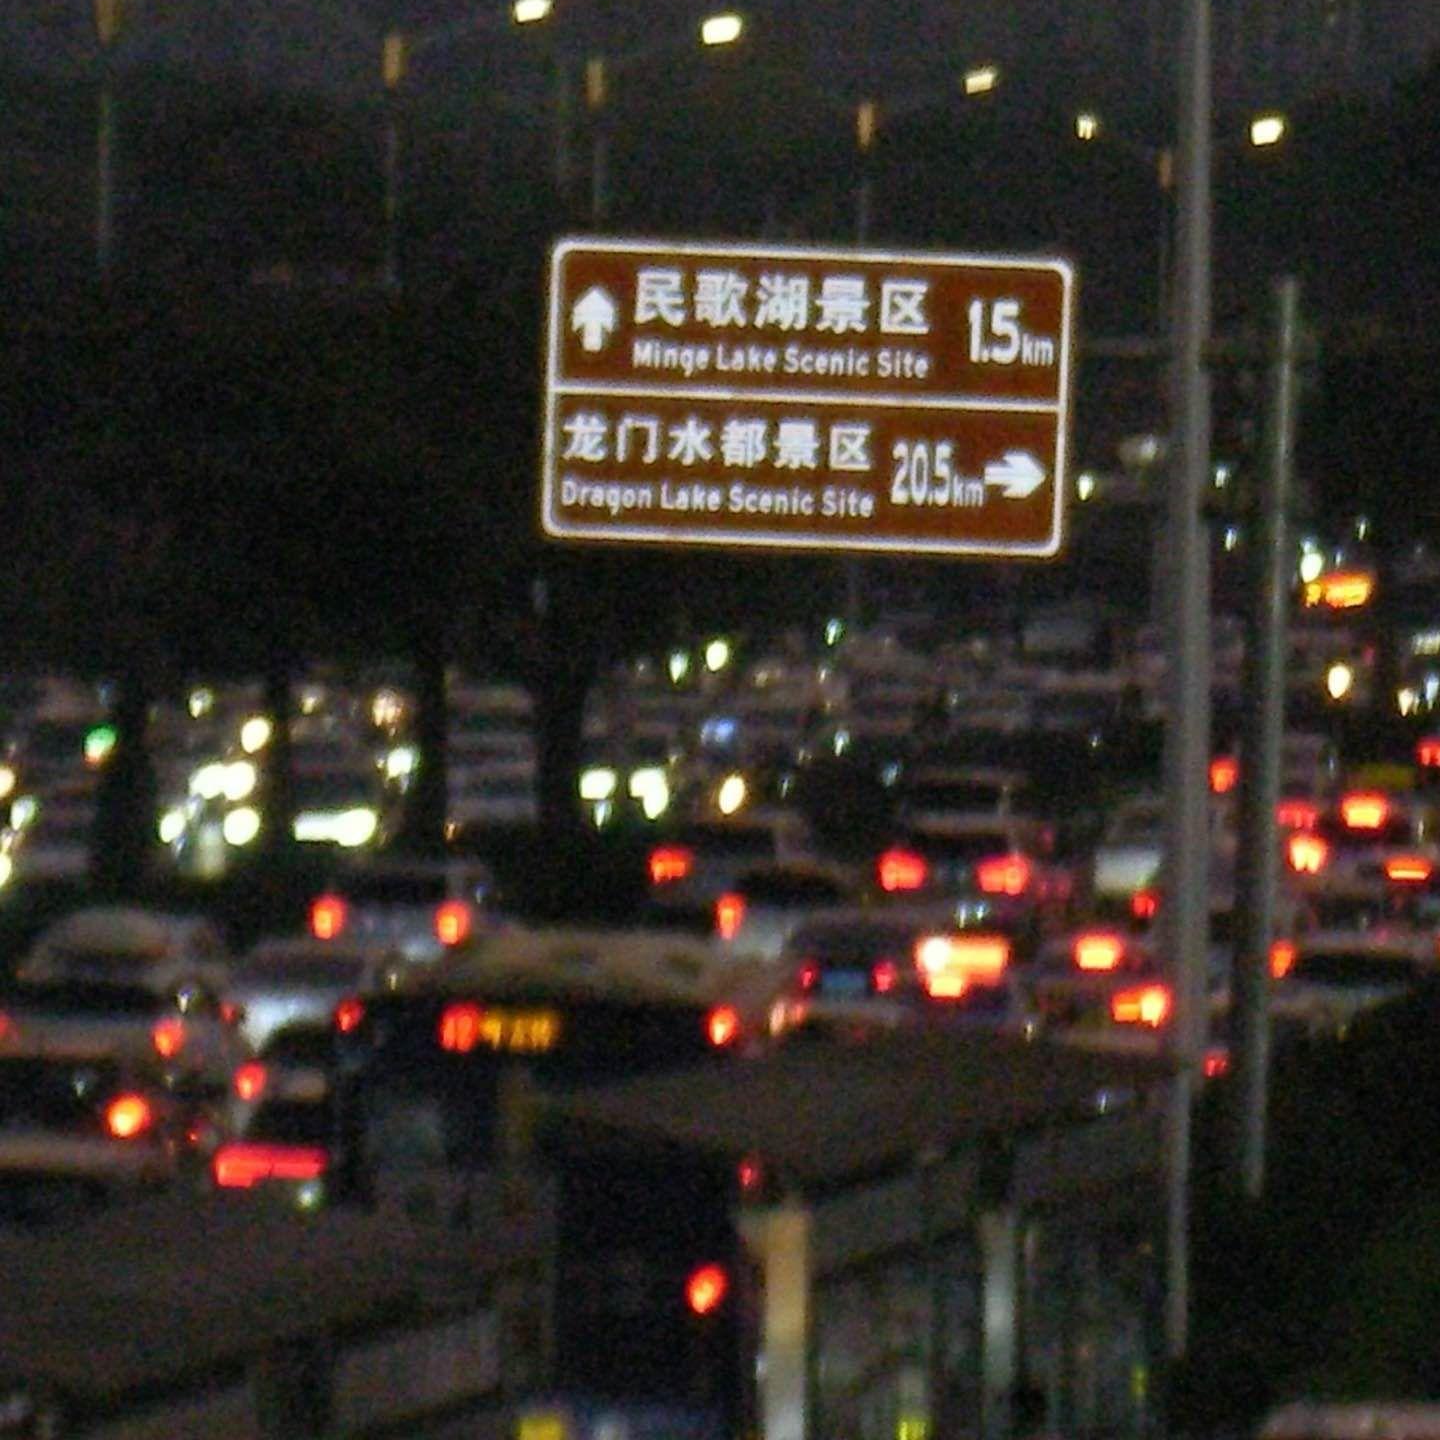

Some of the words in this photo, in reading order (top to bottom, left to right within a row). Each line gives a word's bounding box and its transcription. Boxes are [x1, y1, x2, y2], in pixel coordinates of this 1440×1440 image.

[632, 266, 930, 335] 民歌湖景区
[632, 339, 710, 377] Minge
[715, 344, 777, 373] Lake
[783, 346, 870, 376] Scenic
[876, 347, 930, 378] Site
[562, 409, 873, 471] 龙门水都景区
[561, 479, 653, 516] Dragon
[660, 481, 722, 511] Lake
[727, 481, 815, 516] Scenic
[821, 484, 875, 518] Site
